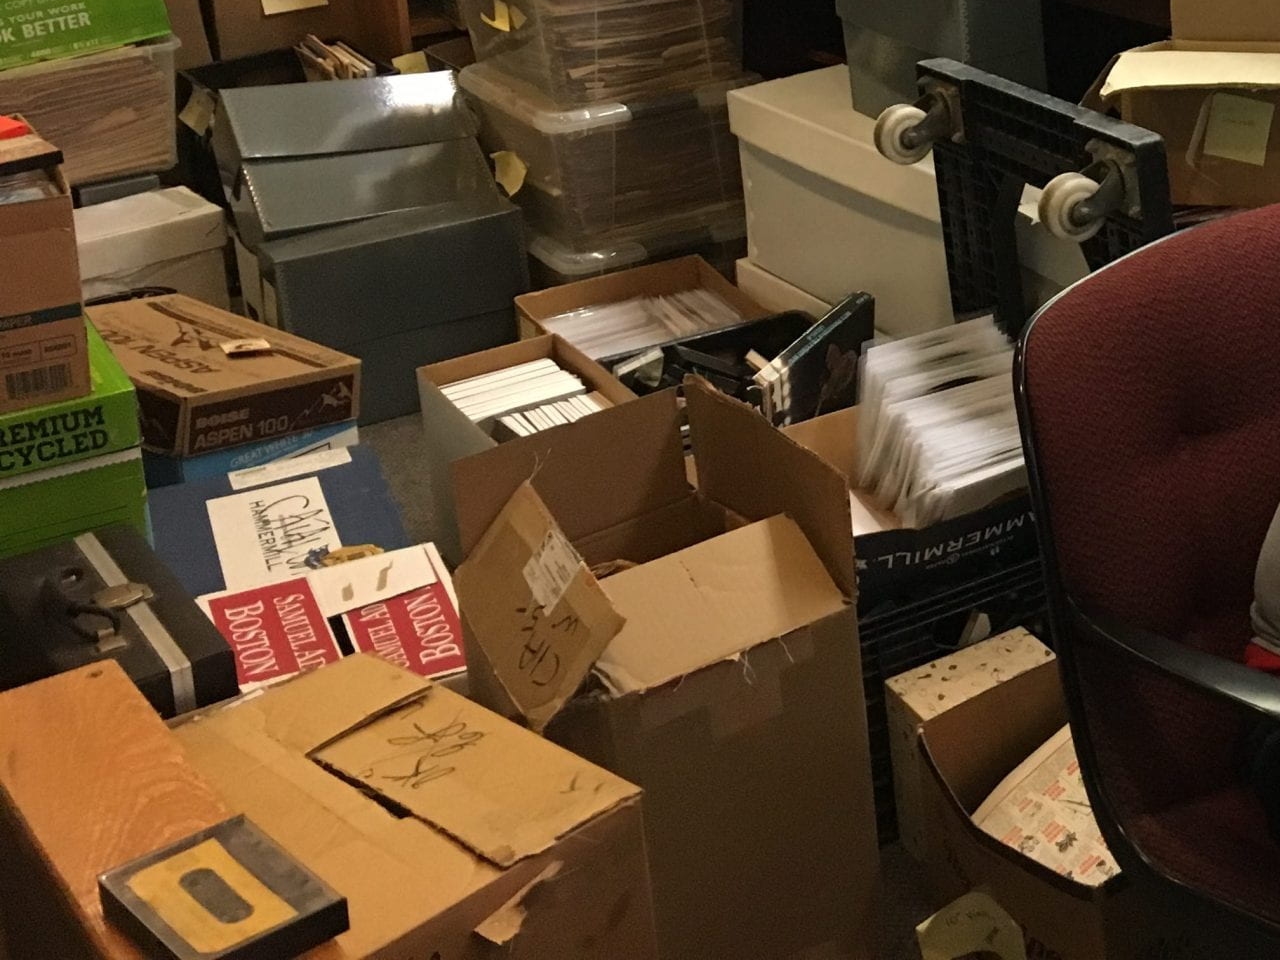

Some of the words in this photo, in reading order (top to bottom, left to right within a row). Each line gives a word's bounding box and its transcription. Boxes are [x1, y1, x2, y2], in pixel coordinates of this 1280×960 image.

[9, 11, 43, 22] YOUR
[47, 2, 86, 15] WORK
[22, 12, 92, 38] BETTER
[139, 343, 222, 375] ASPEN
[192, 423, 254, 449] ASPEN
[257, 415, 291, 436] 100
[229, 445, 264, 468] GREAT
[248, 499, 284, 574] HAMMERMILL
[224, 598, 282, 677] BOSTON
[273, 593, 318, 649] SAMUEL
[403, 593, 462, 665] BOSTON
